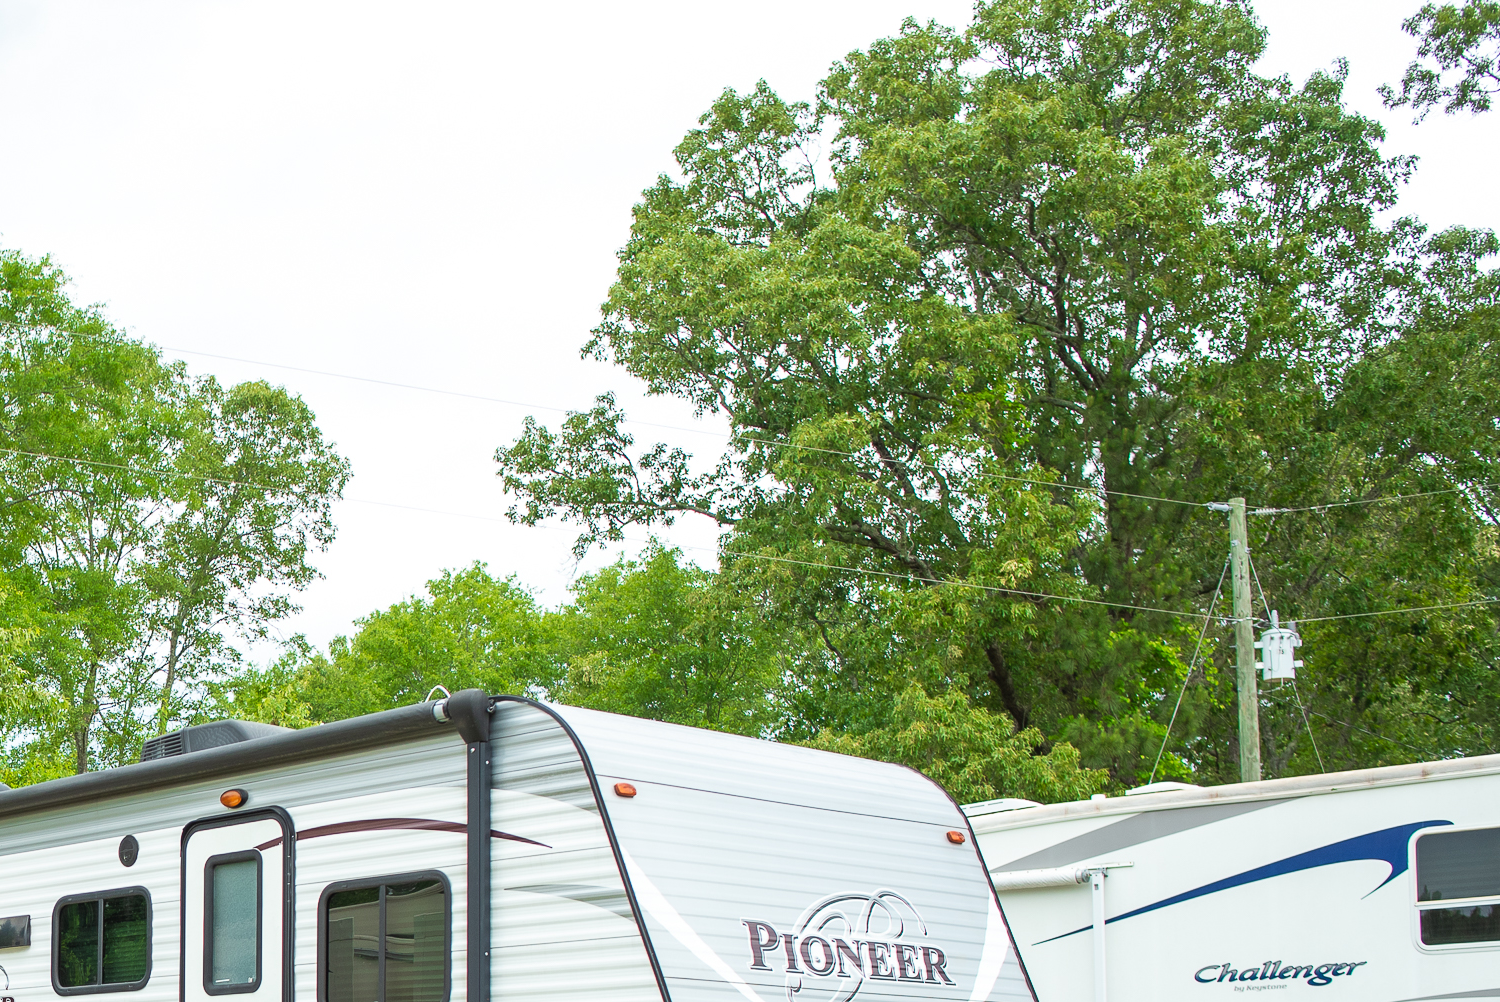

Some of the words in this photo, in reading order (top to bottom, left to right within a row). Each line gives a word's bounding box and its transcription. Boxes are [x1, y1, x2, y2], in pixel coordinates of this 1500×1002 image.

[740, 918, 957, 987] PIONEER
[1194, 960, 1368, 987] Challenger
[1233, 985, 1245, 993] by
[1246, 984, 1288, 992] Keystone
